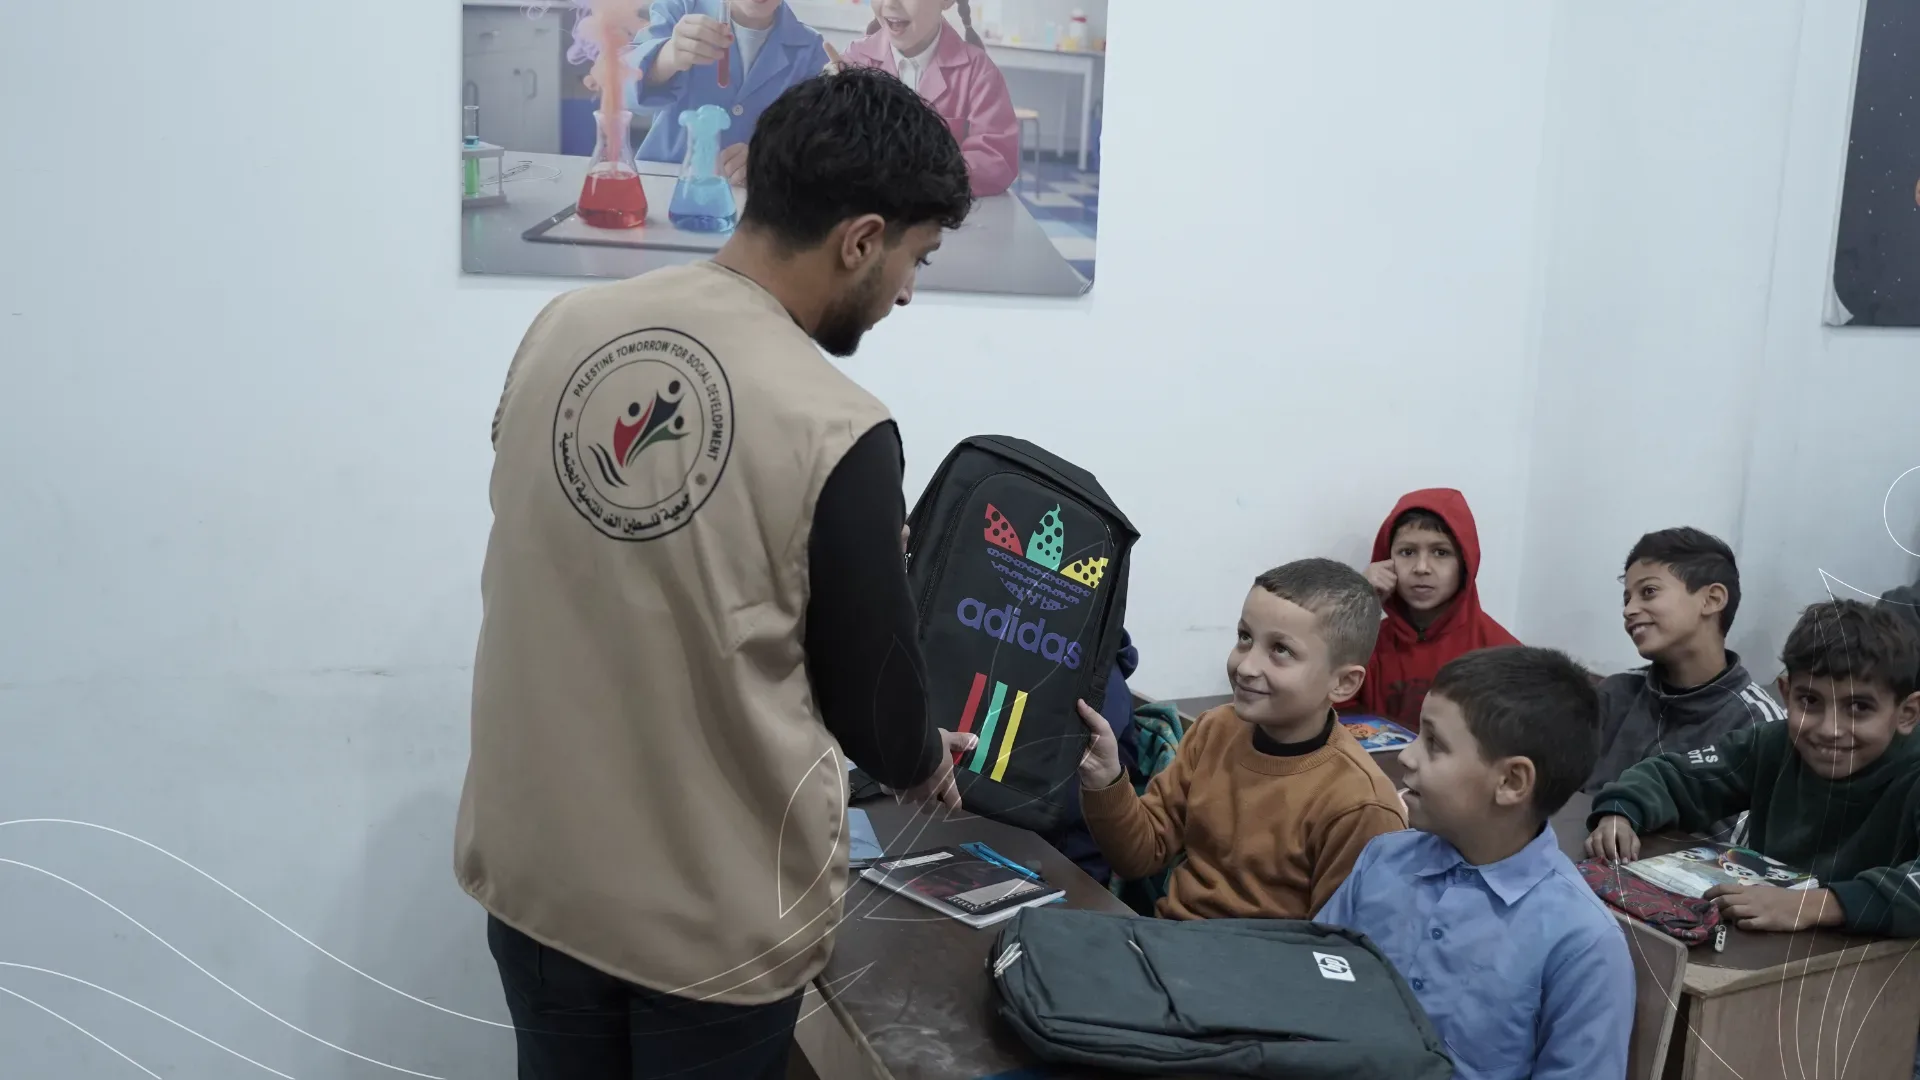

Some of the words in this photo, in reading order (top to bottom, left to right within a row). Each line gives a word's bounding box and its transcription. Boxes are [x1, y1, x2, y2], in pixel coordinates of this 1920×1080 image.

[574, 353, 616, 398] PALESTINE
[616, 340, 670, 359] TOMORROW
[671, 343, 689, 360] FOR
[686, 353, 712, 385] SOCIAL
[705, 382, 724, 462] DEVELOPMENT
[623, 513, 661, 536] فلسطين
[957, 597, 1082, 670] adidas
